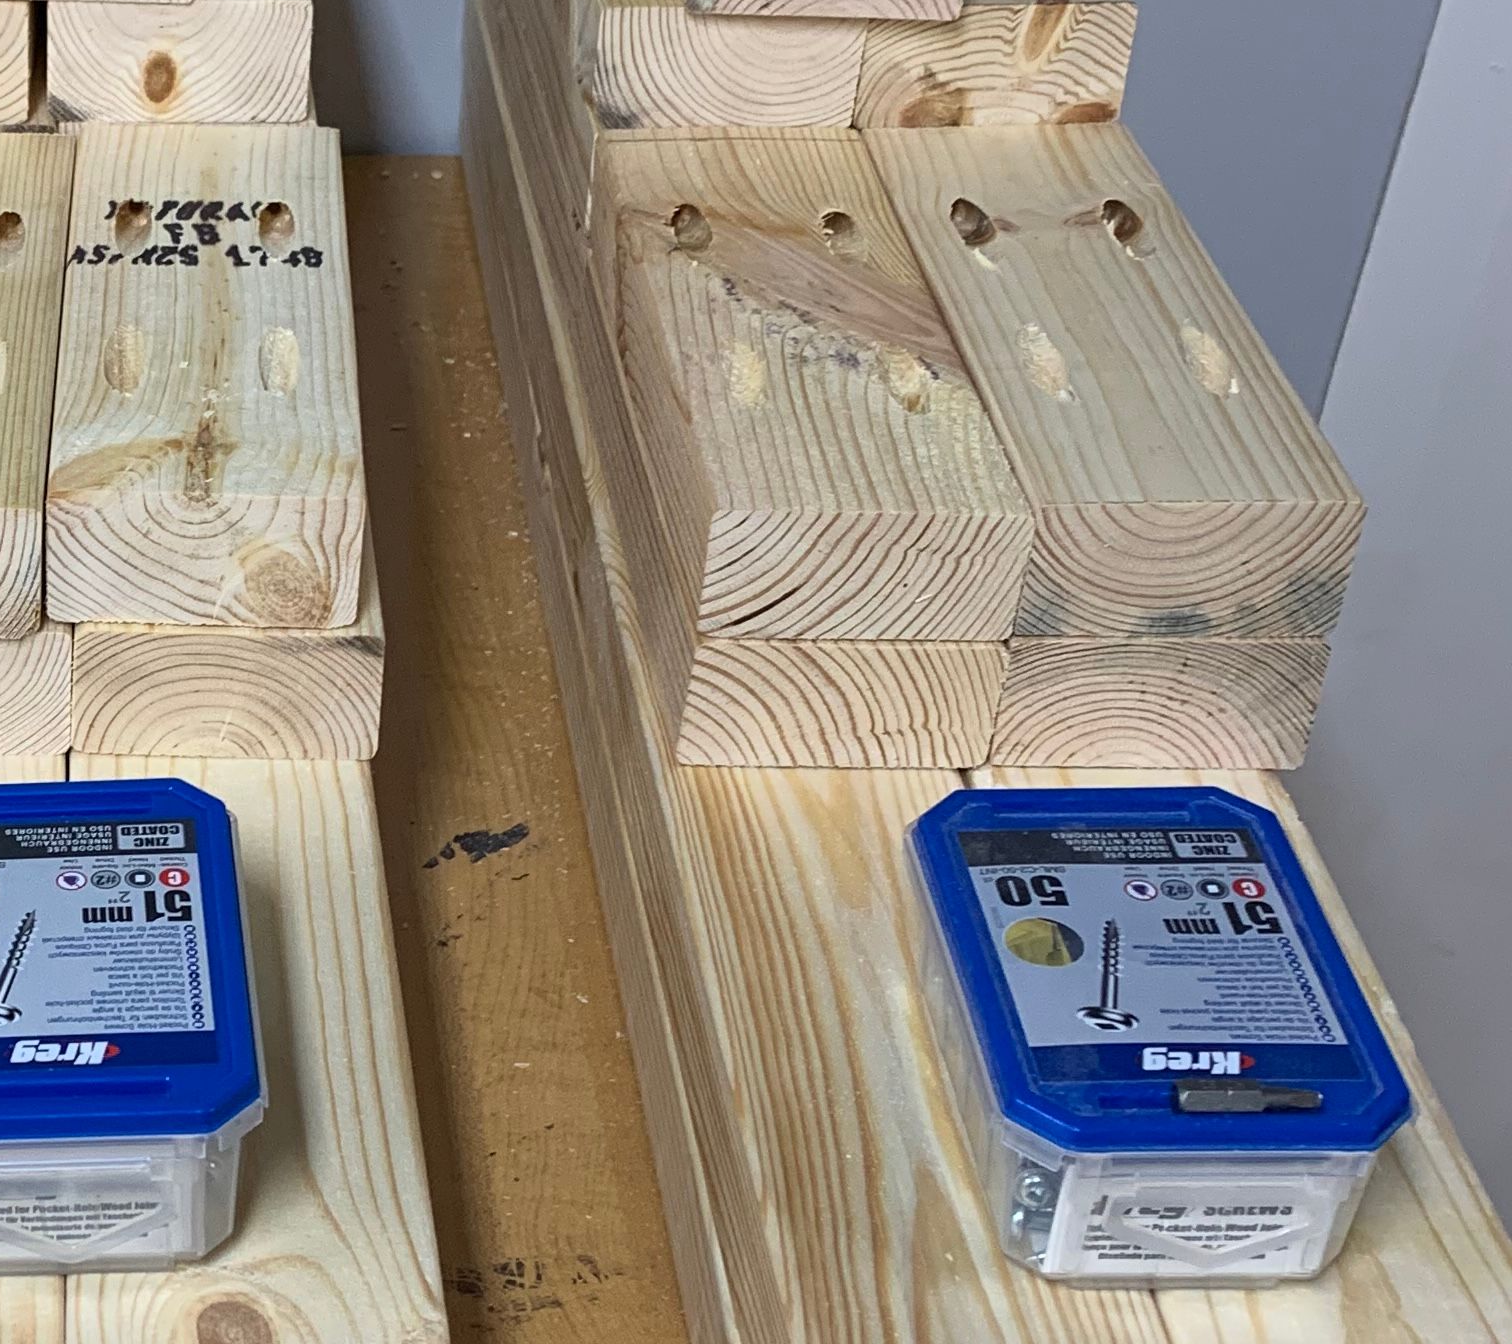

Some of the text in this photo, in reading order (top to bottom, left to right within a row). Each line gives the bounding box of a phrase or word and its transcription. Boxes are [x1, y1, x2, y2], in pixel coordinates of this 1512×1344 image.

[4, 827, 69, 835] INTERIORES
[120, 825, 180, 836] COATED
[20, 838, 113, 847] INNENGEBRAUCH
[133, 836, 170, 847] ZINC
[1173, 833, 1238, 844] COATED
[71, 844, 113, 852] INDOOR
[1191, 845, 1231, 856] ZINC
[994, 875, 1070, 907] 50
[82, 890, 193, 924] 51 mm
[1162, 901, 1284, 935] 51 mm
[9, 1039, 108, 1066] Kreg
[1142, 1047, 1241, 1075] Kreg
